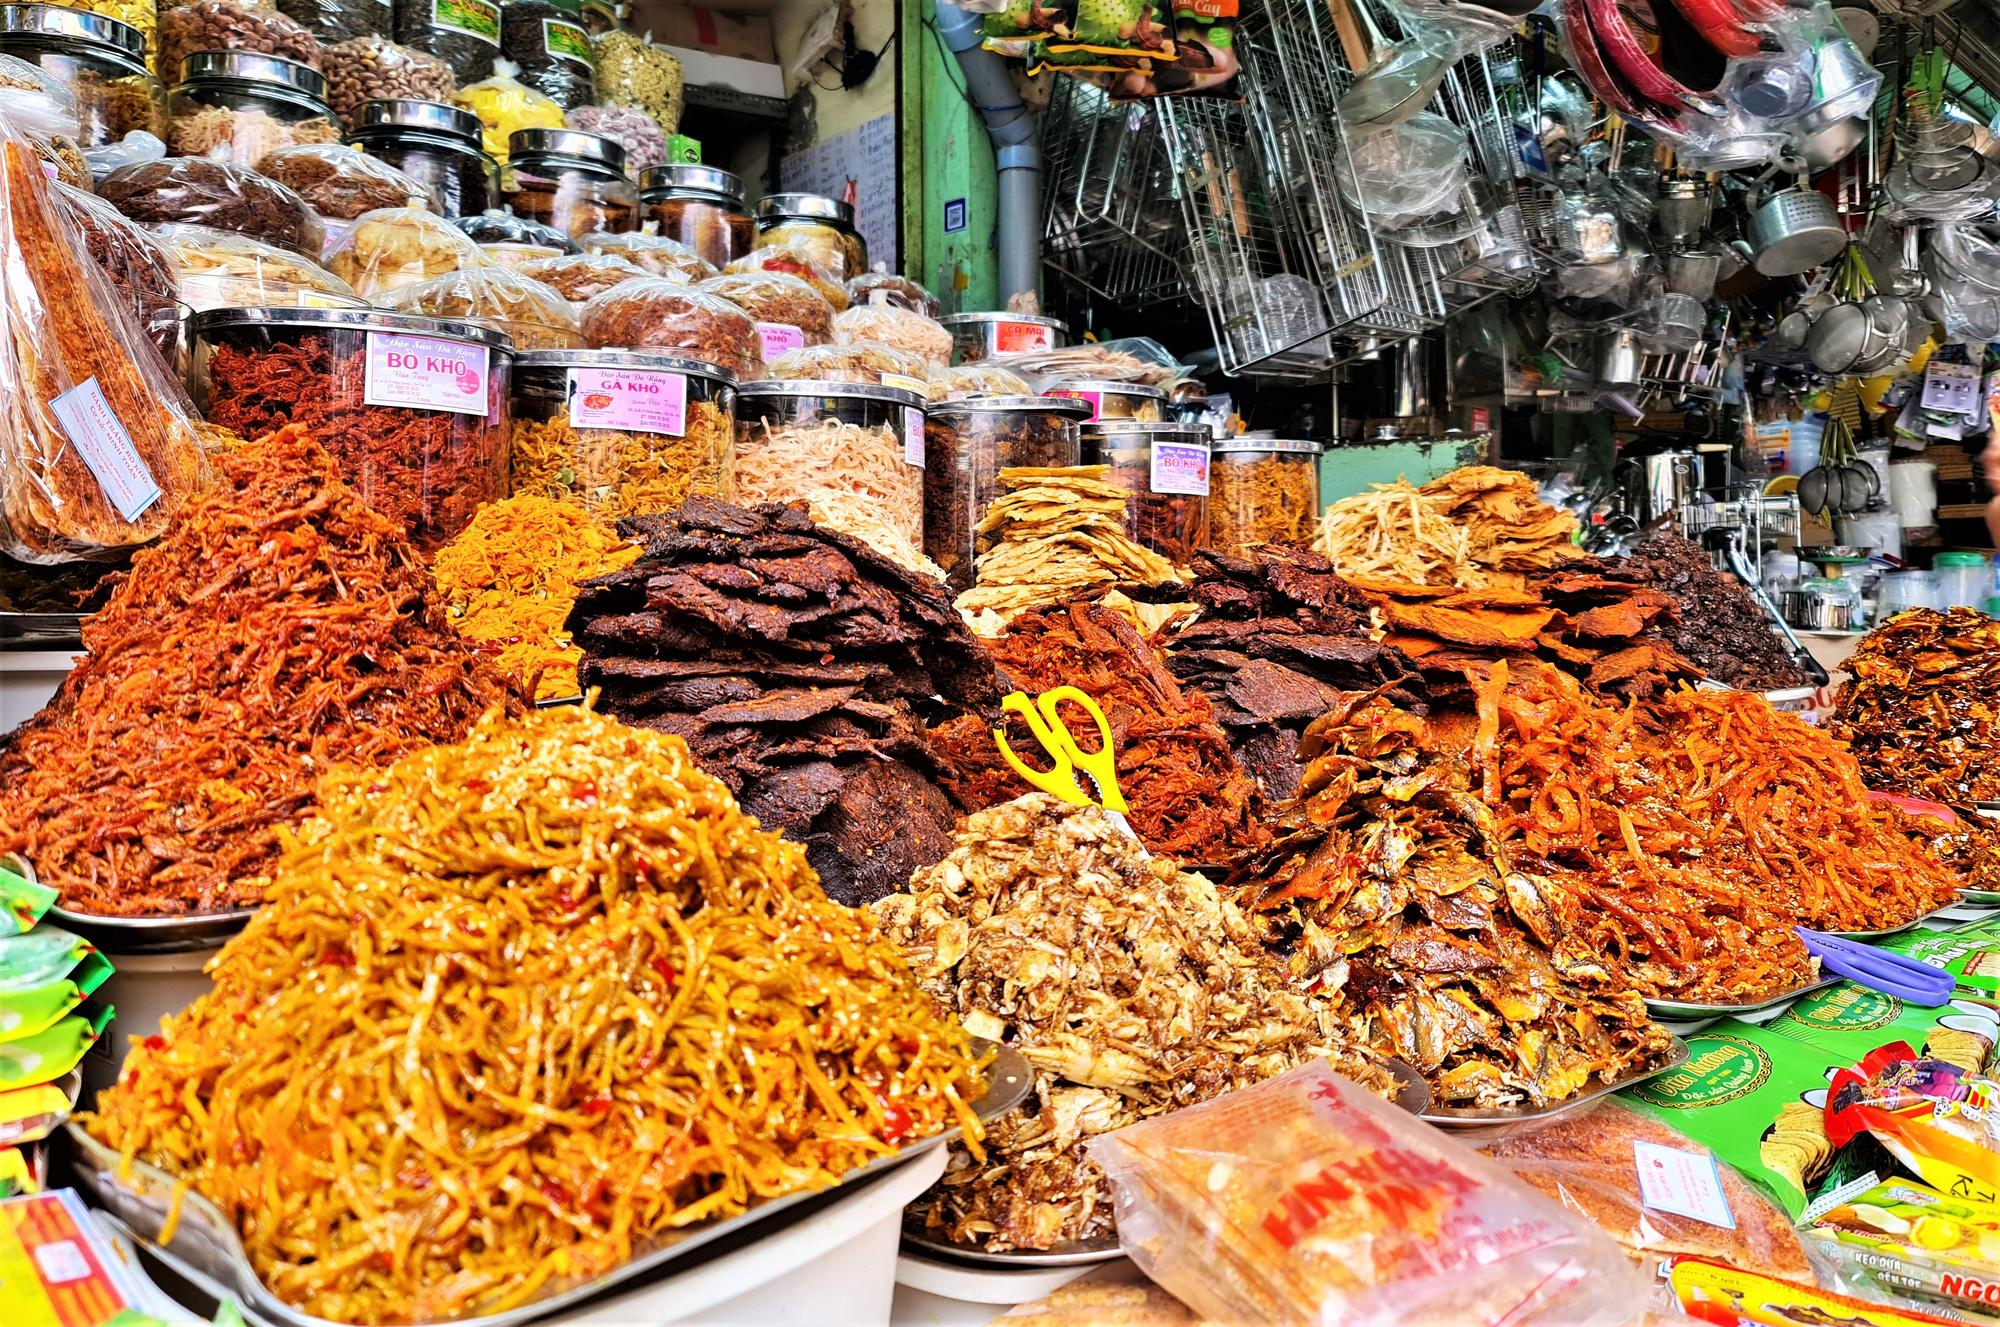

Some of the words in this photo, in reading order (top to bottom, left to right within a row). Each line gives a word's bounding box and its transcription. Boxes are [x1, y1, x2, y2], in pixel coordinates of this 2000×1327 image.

[766, 335, 788, 343] KHÔ
[1025, 327, 1045, 337] MAI
[387, 348, 419, 370] BÒ
[426, 356, 467, 376] KHÔ
[601, 379, 622, 391] GÀ
[628, 382, 659, 394] KHÔ
[90, 391, 107, 421] BÁNH
[106, 419, 127, 450] TRÁNG
[134, 463, 148, 485] KHÔ
[105, 432, 123, 456] MINH
[1164, 454, 1180, 468] BÒ
[1183, 457, 1201, 470] KHÔ
[1806, 1004, 1846, 1022] Dừa
[1826, 984, 1877, 1008] Nướng
[1648, 1073, 1698, 1097] Dừa
[1680, 1045, 1749, 1077] Nướng
[1681, 1091, 1708, 1100] Đặc
[1708, 1085, 1728, 1096] sản
[1722, 1072, 1752, 1089] Quảng
[1739, 1058, 1755, 1074] Nam
